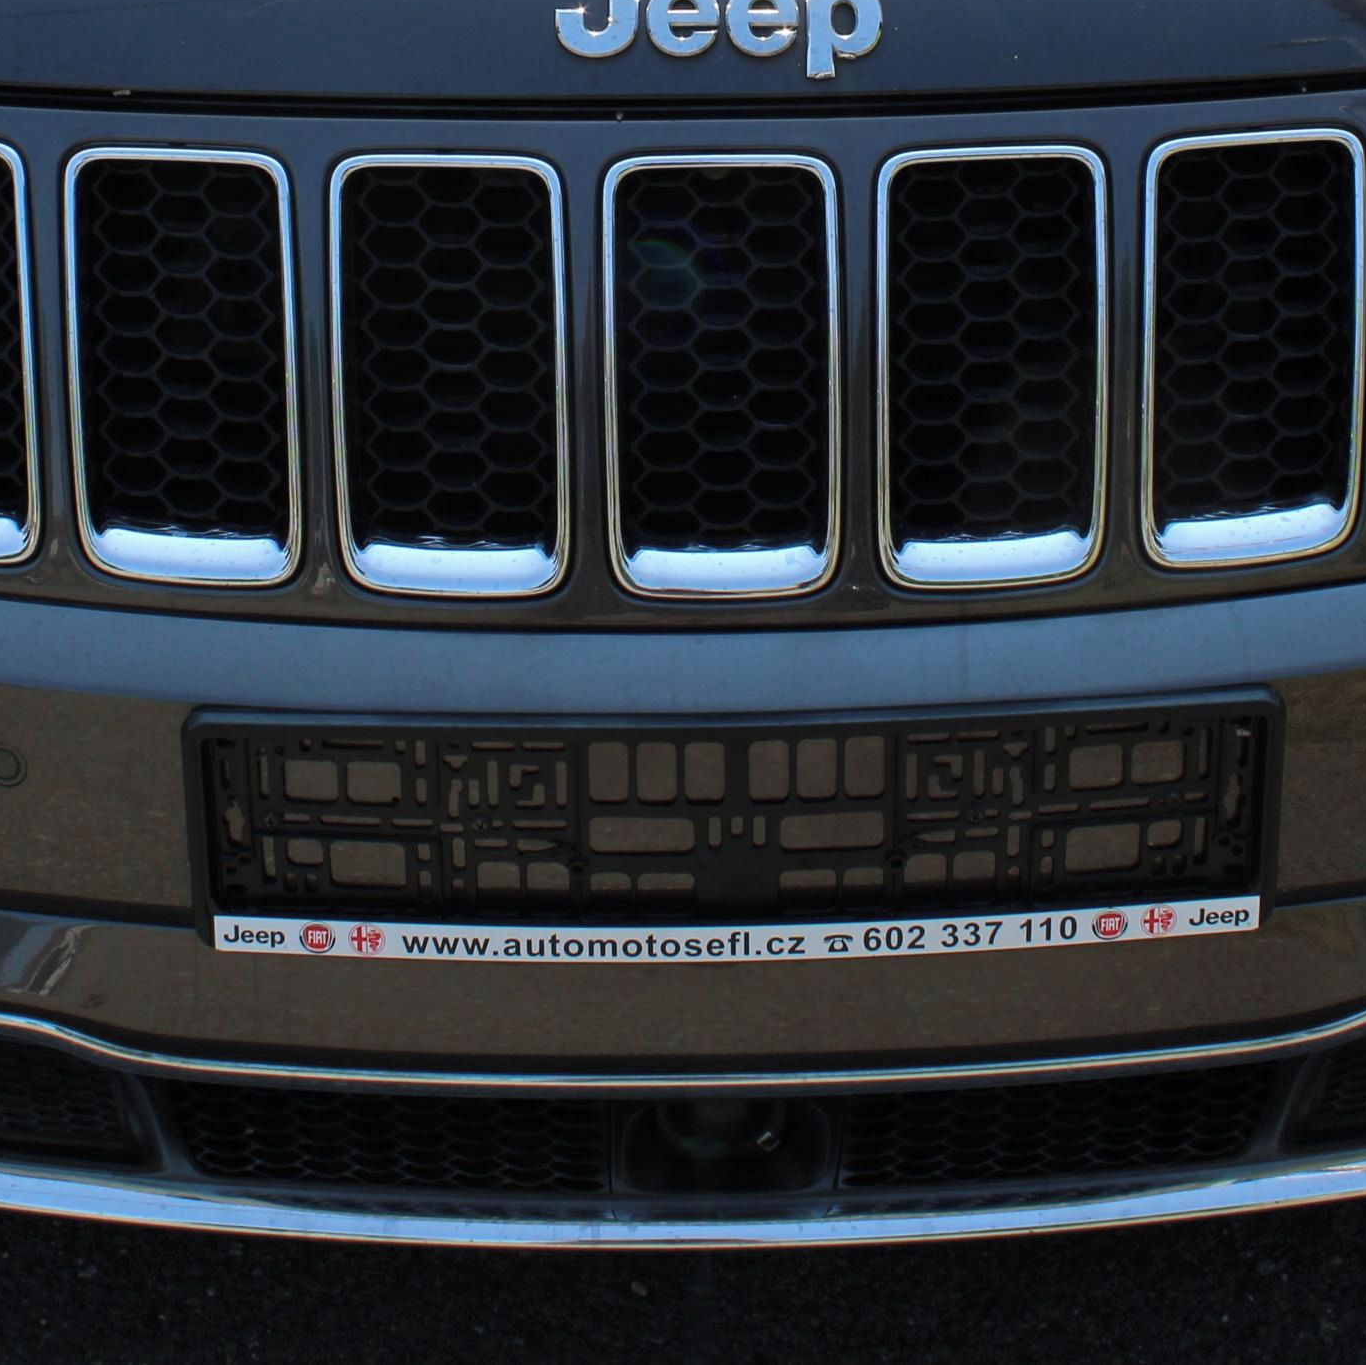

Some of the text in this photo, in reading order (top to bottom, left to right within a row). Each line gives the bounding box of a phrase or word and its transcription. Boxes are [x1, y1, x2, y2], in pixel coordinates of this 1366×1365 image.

[223, 907, 1250, 957] Jeep FIAT www.automotosefl.cz 602 337 110 FIAT Jeep
